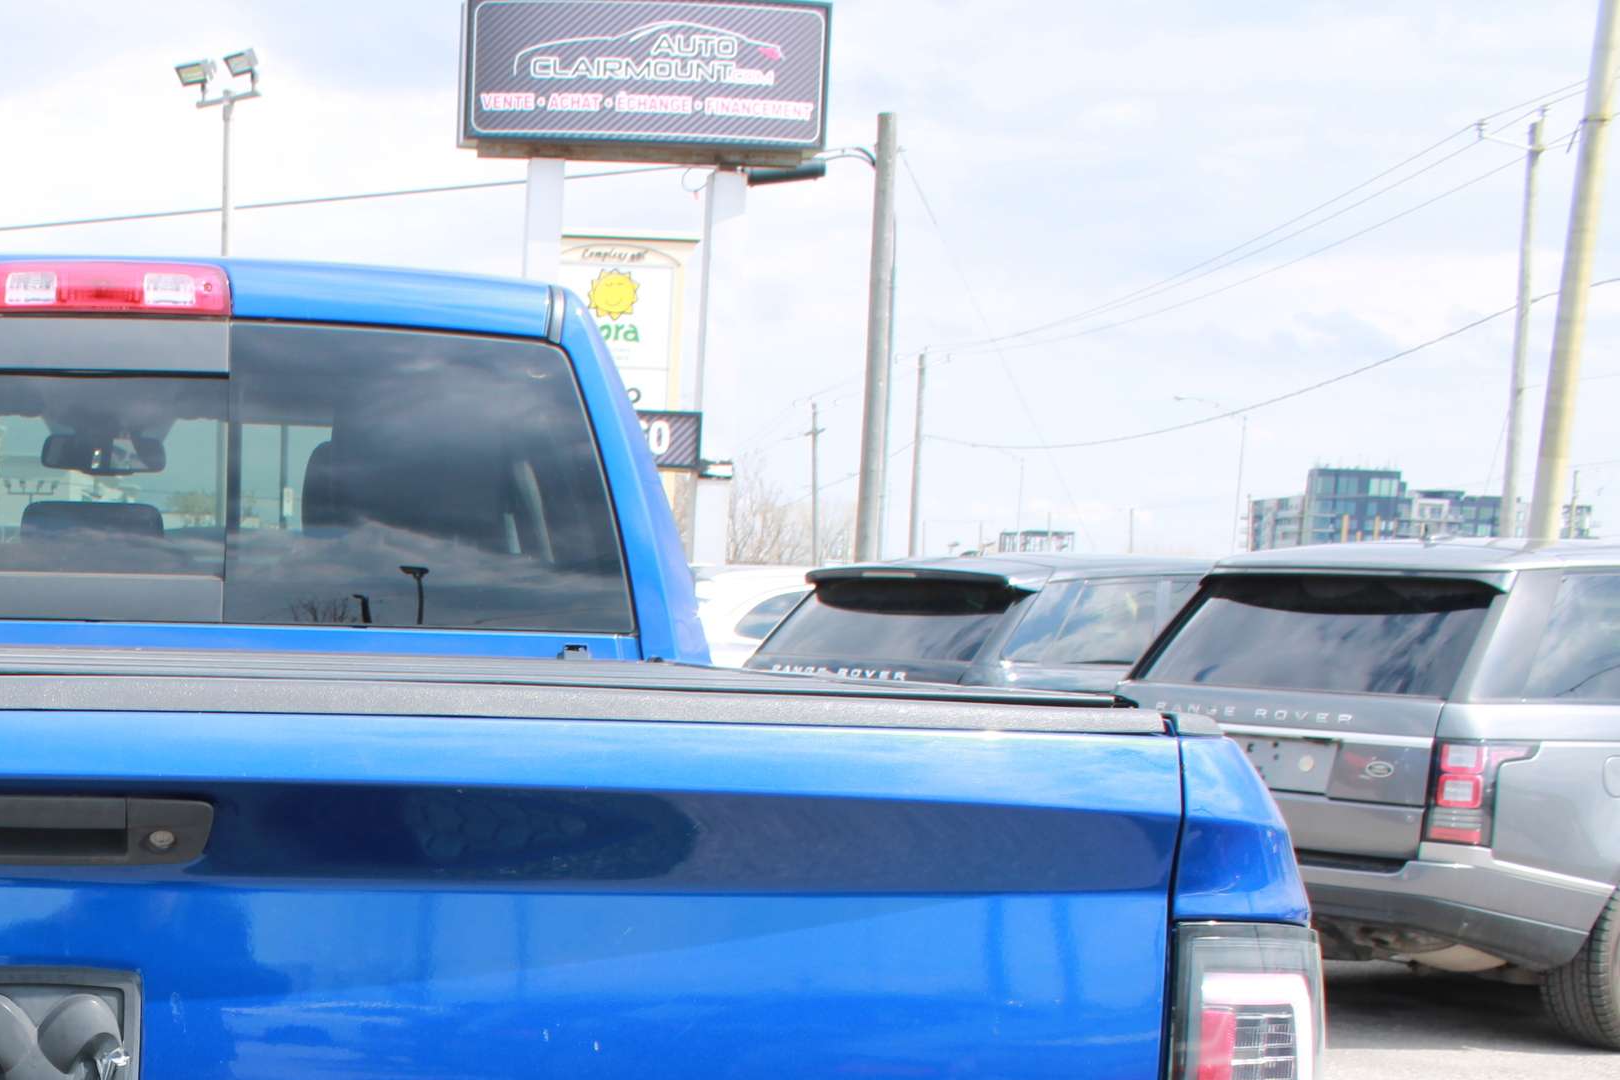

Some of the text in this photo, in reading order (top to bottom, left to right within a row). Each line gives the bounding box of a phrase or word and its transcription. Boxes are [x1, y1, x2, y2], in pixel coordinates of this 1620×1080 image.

[650, 33, 738, 58] AUTO
[480, 90, 814, 121] VENTE ACHAT ÉCHANGE FINANCEMENT
[599, 323, 640, 343] ora
[836, 667, 908, 681] ROVER
[1254, 708, 1353, 724] ROVER
